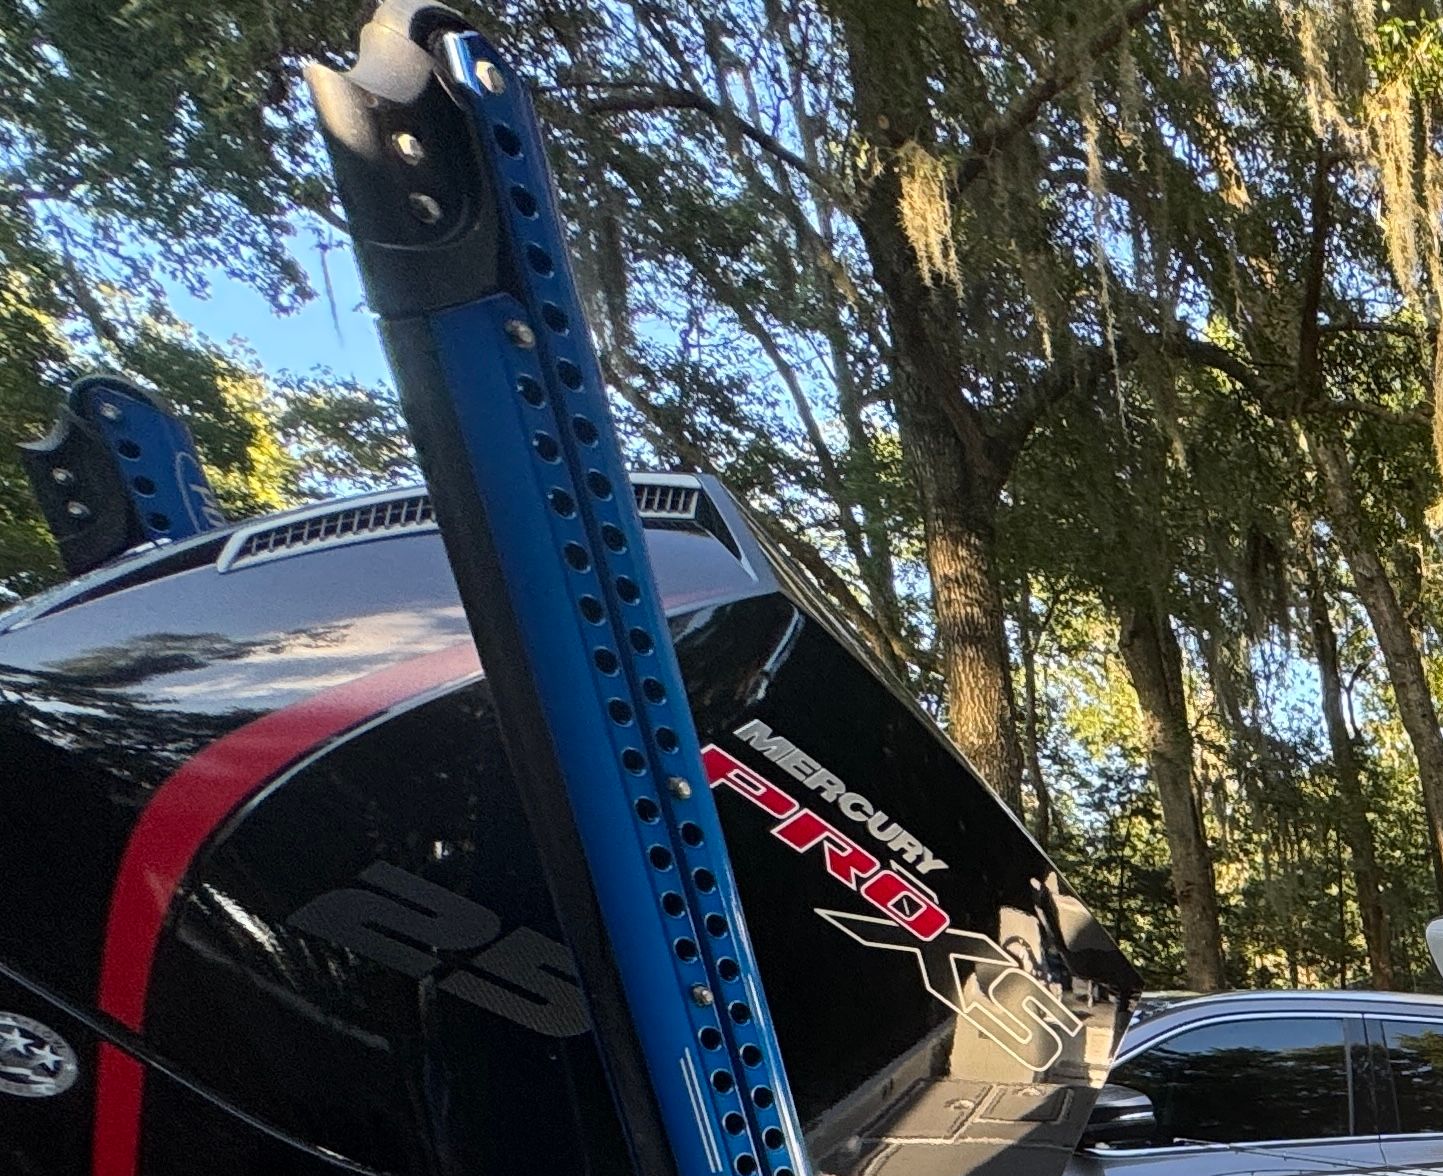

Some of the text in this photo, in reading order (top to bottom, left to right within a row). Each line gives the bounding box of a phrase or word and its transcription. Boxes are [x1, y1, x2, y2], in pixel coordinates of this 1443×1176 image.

[701, 743, 1083, 1073] PRO XS
[733, 718, 949, 875] MERCURY
